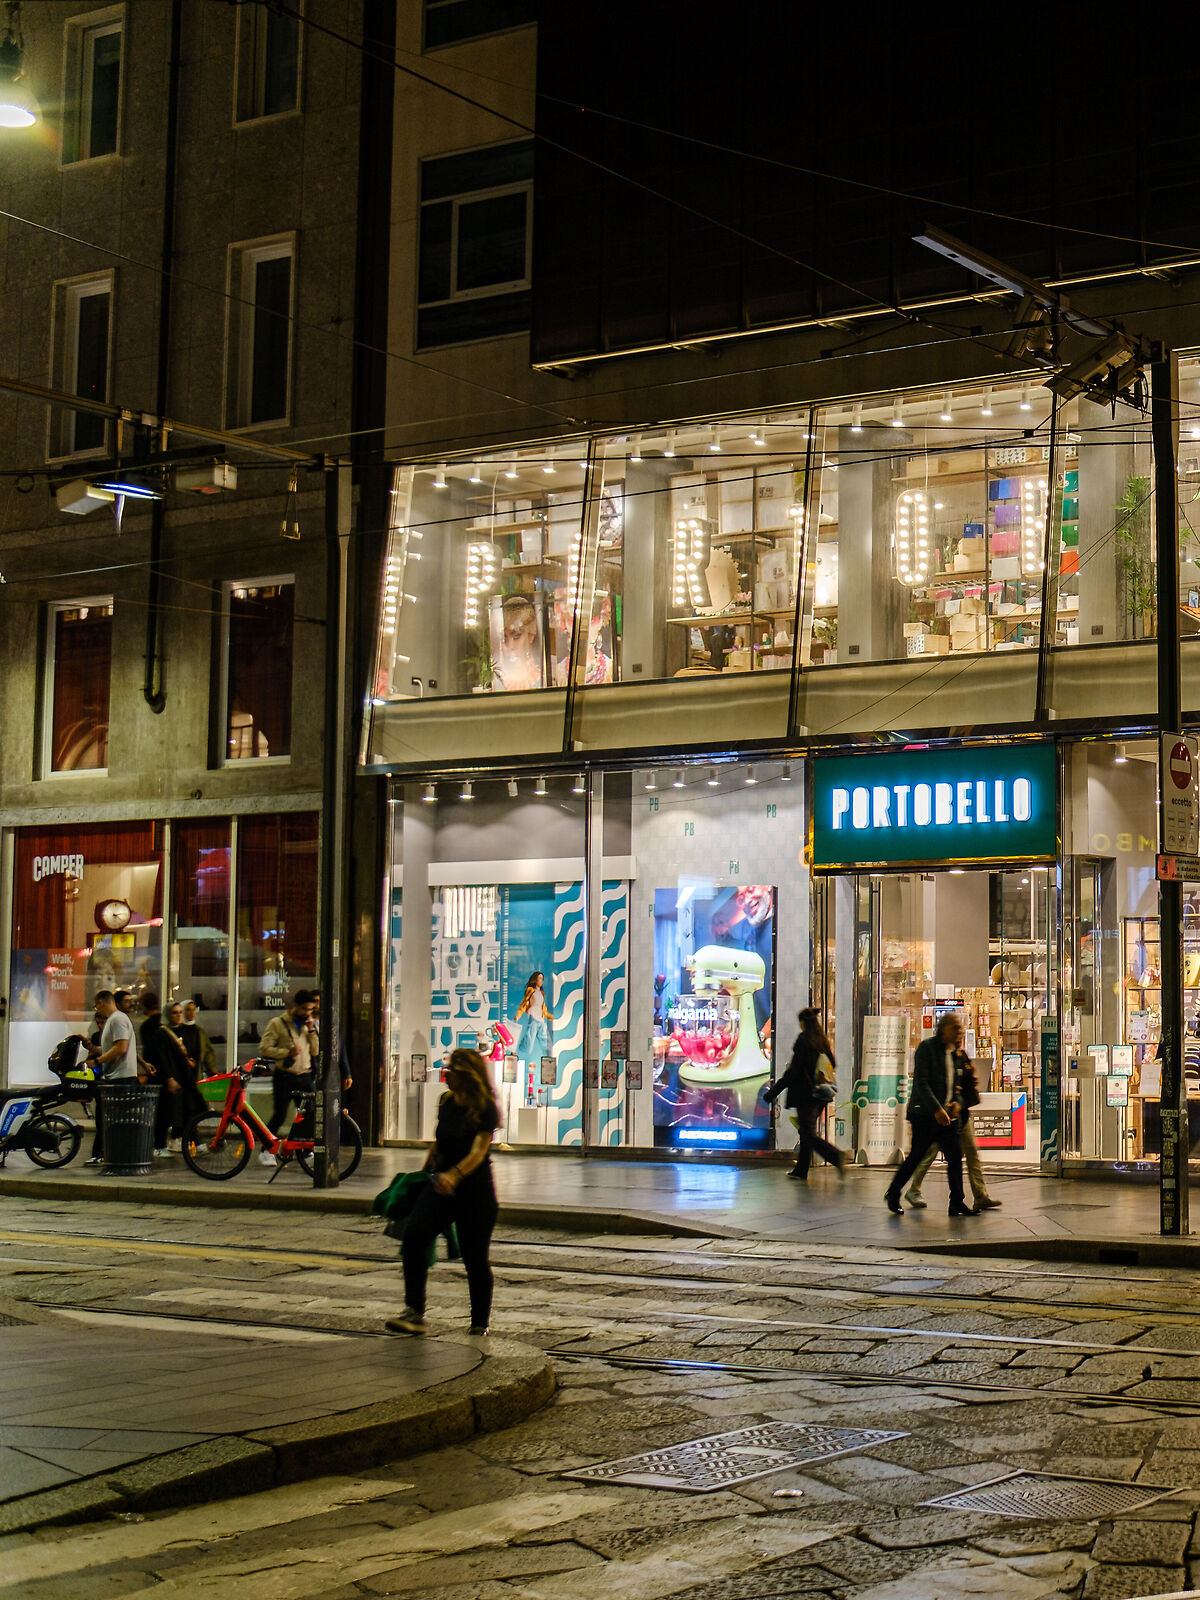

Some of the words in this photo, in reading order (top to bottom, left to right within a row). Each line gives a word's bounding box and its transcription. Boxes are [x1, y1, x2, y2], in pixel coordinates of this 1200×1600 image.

[649, 798, 659, 811] PB
[832, 778, 1031, 829] PORTOBELLO
[1171, 798, 1191, 806] eccetto
[767, 805, 776, 818] PB
[685, 823, 694, 836] PB
[33, 854, 84, 881] CAMPER
[52, 953, 74, 965] Walk,
[51, 979, 69, 990] Run.
[265, 995, 286, 1007] Run.
